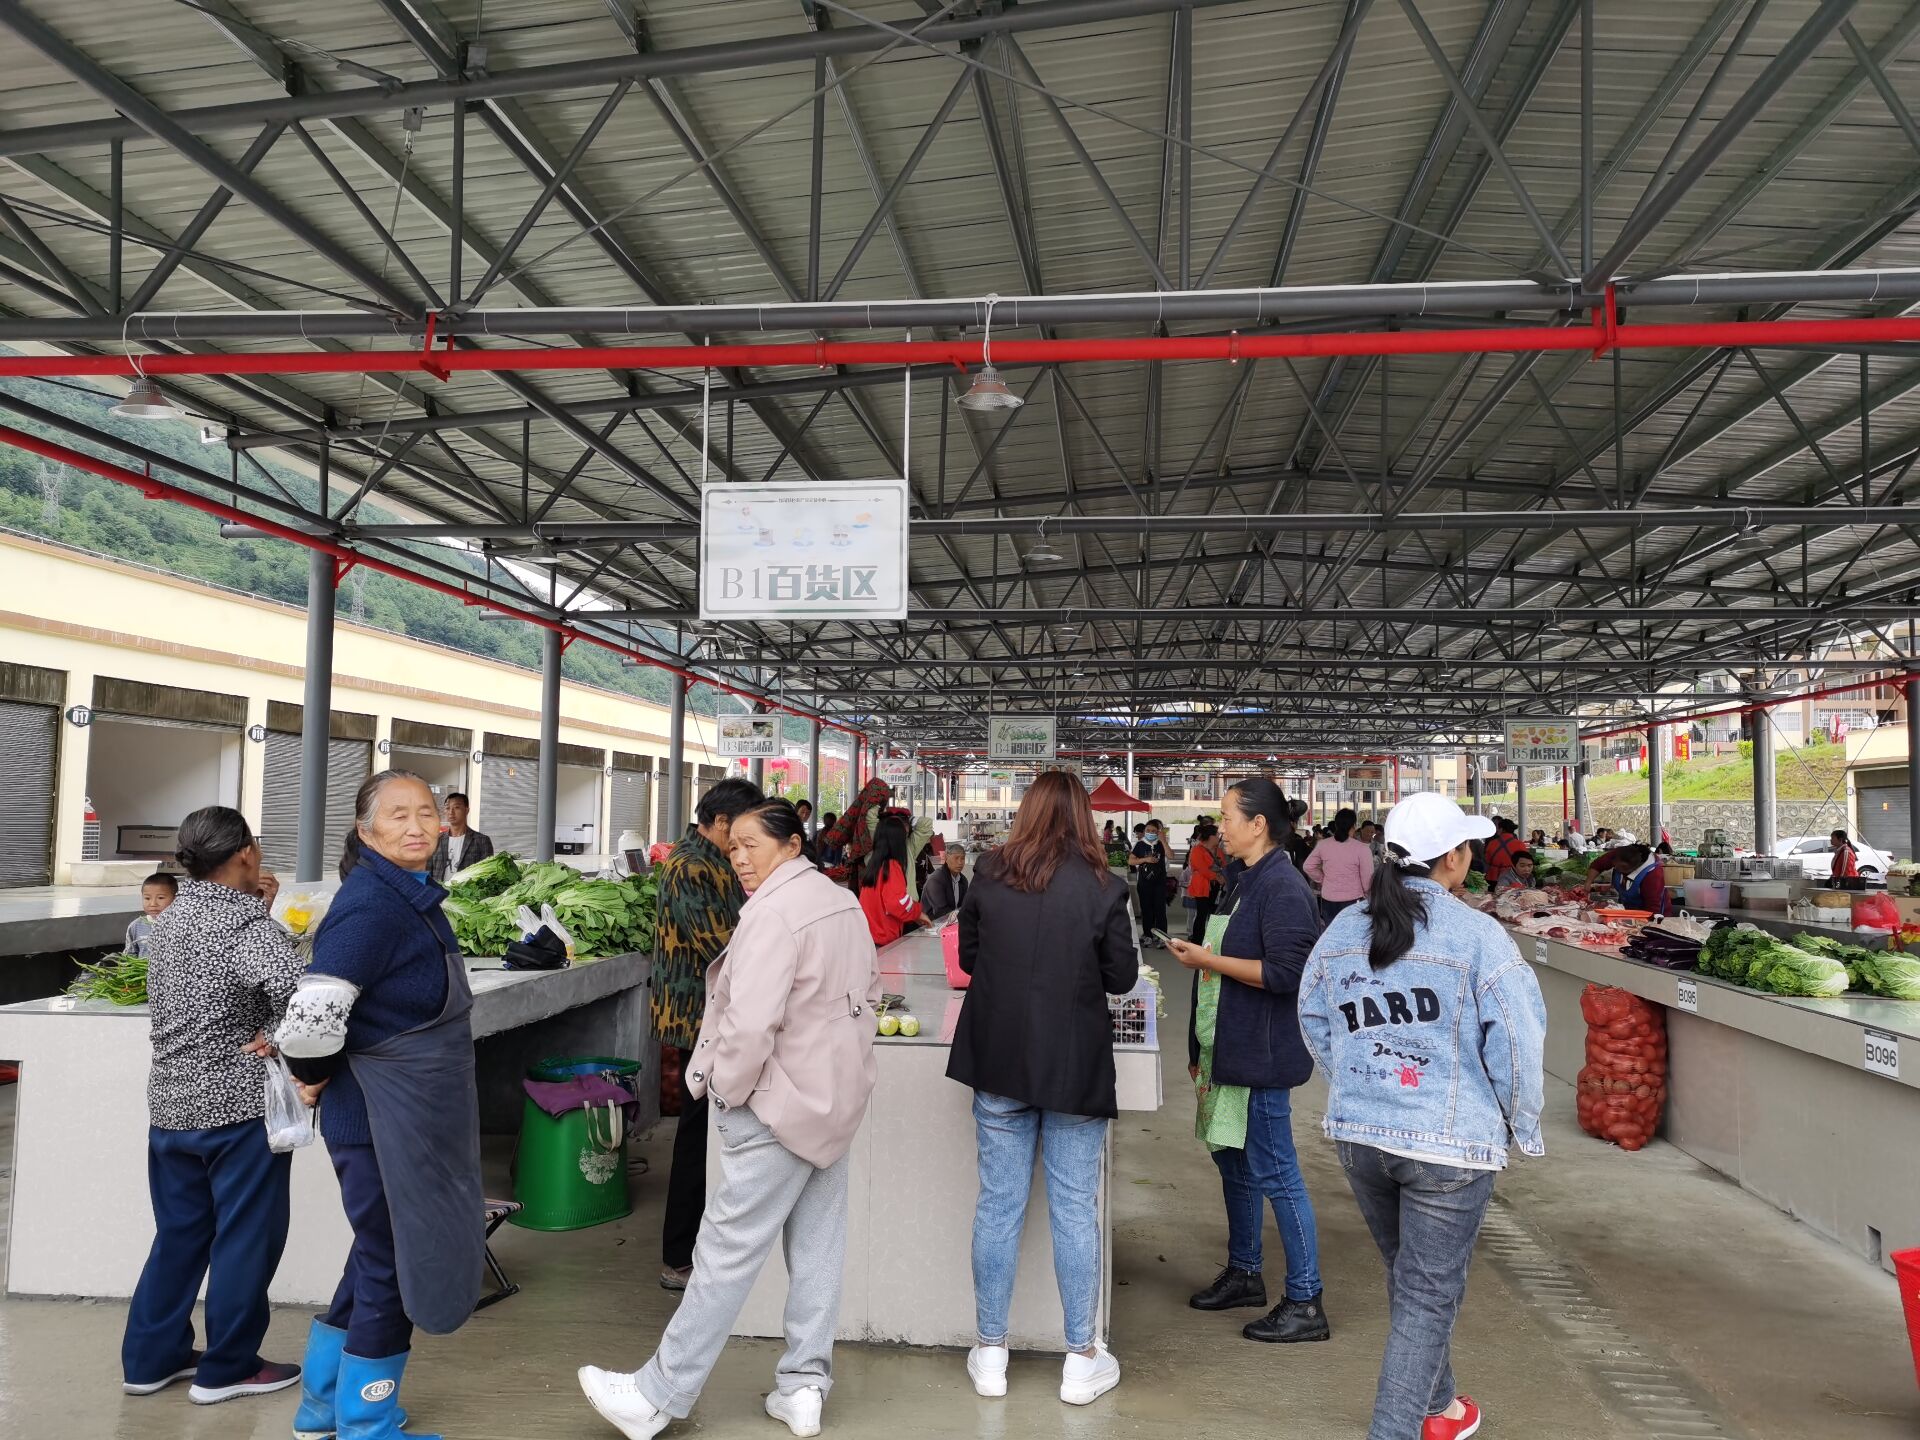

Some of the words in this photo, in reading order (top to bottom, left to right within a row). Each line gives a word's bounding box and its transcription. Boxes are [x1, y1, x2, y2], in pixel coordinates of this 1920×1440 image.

[719, 564, 878, 600] B1百货区
[72, 710, 89, 723] 017
[251, 728, 265, 740] 016
[1512, 747, 1571, 760] B5水果区
[1679, 988, 1696, 1004] B095
[1865, 1042, 1897, 1067] B096
